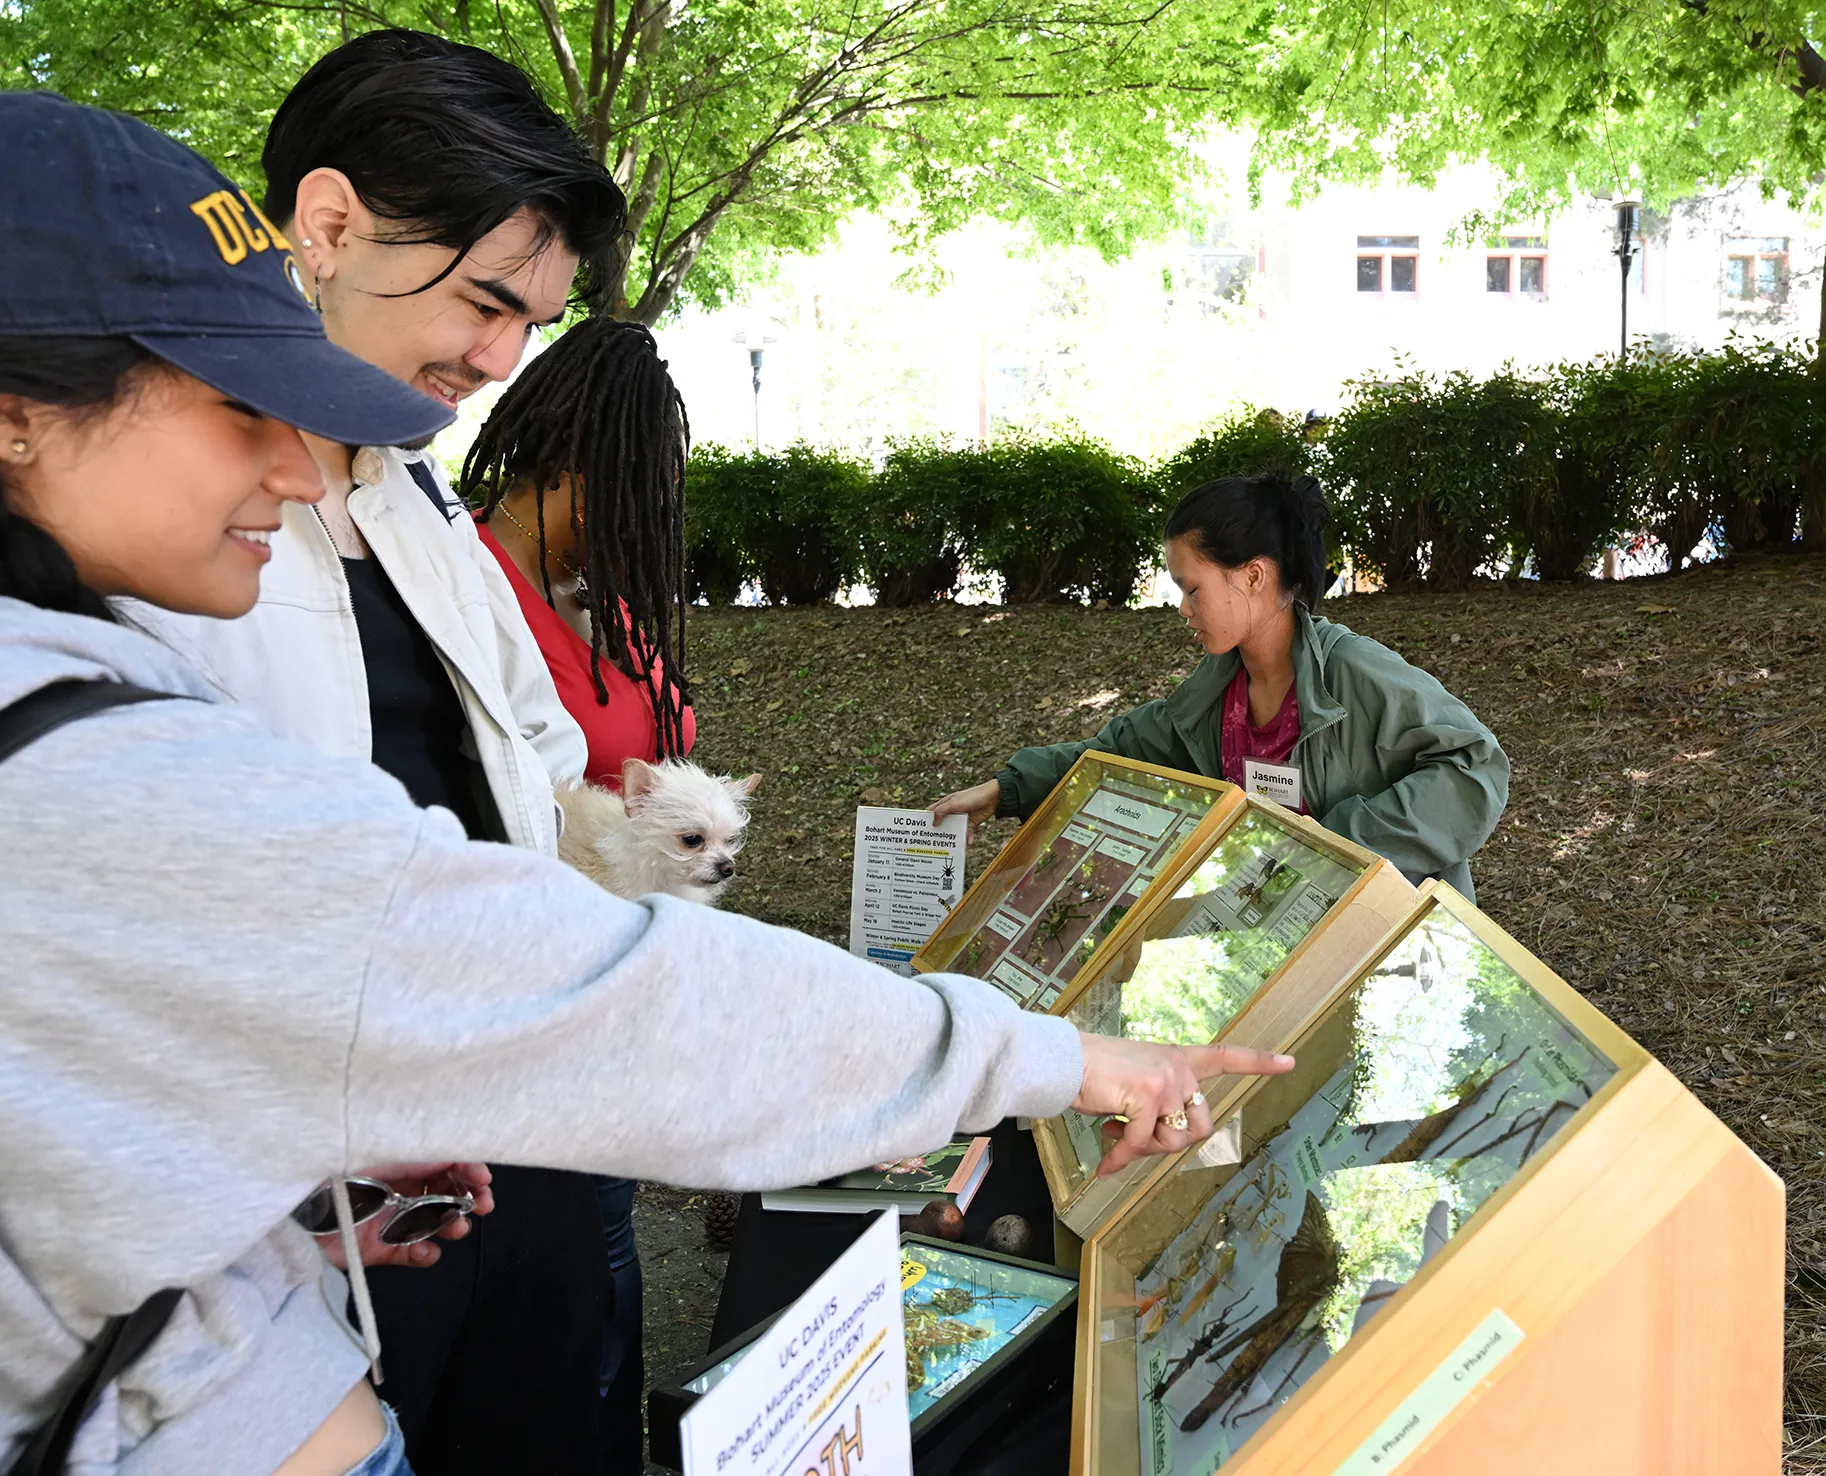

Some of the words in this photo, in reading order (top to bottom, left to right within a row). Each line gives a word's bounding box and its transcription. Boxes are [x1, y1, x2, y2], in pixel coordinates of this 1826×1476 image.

[1252, 770, 1294, 786] Jasmine
[893, 817, 904, 825] UC
[906, 818, 927, 827] Davis
[1114, 805, 1142, 820] Arachnids
[864, 834, 878, 842] 2025
[880, 836, 902, 844] WINTER
[909, 838, 932, 846] SPRING
[932, 840, 956, 848] EVENTS
[865, 826, 885, 834] Bohart
[886, 828, 910, 836] Museum
[919, 830, 957, 840] Entomology
[866, 873, 886, 881] February
[778, 1337, 800, 1370] UC
[803, 1296, 838, 1347] DAVIS
[1151, 1351, 1162, 1374] Two
[1462, 1331, 1502, 1372] Phasmid
[716, 1414, 762, 1472] Bohart
[765, 1358, 815, 1419] Museum
[816, 1340, 828, 1362] of
[829, 1276, 887, 1346] Entomology
[751, 1393, 804, 1463] SUMMER
[806, 1363, 832, 1401] 2025
[833, 1321, 866, 1368] EVENT
[1155, 1409, 1166, 1436] Stick
[1381, 1413, 1420, 1454] Phasmid
[1156, 1433, 1168, 1474] Mimics
